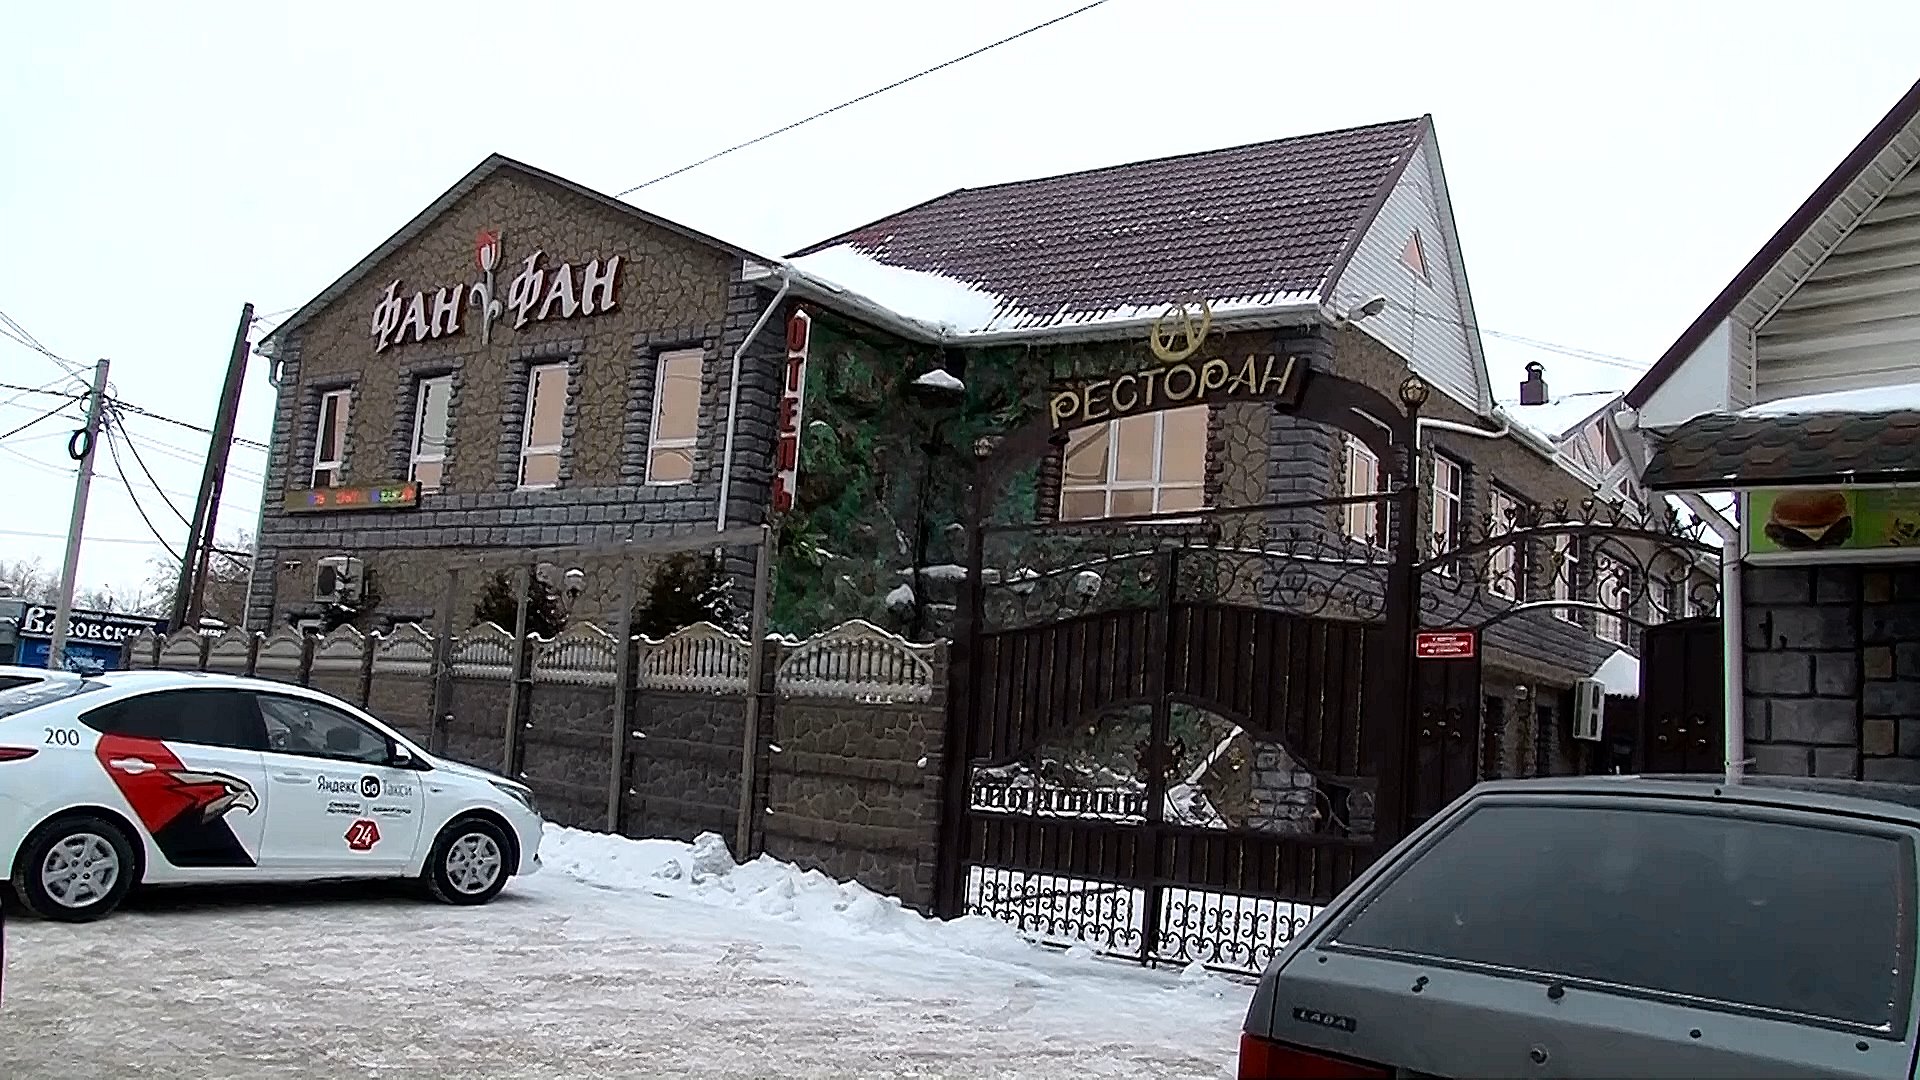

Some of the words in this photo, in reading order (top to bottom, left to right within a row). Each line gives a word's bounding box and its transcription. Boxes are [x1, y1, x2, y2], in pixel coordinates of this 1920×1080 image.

[371, 279, 464, 353] ФАН
[508, 250, 620, 330] ФАН
[1049, 354, 1297, 430] РЕСТОРАН
[771, 317, 808, 514] ОТЕЛЬ
[44, 727, 80, 746] 200
[317, 775, 357, 794] Яндекс
[362, 779, 379, 796] Go
[382, 779, 412, 798] Такси
[352, 824, 373, 845] 24
[1300, 1010, 1347, 1029] LADA
